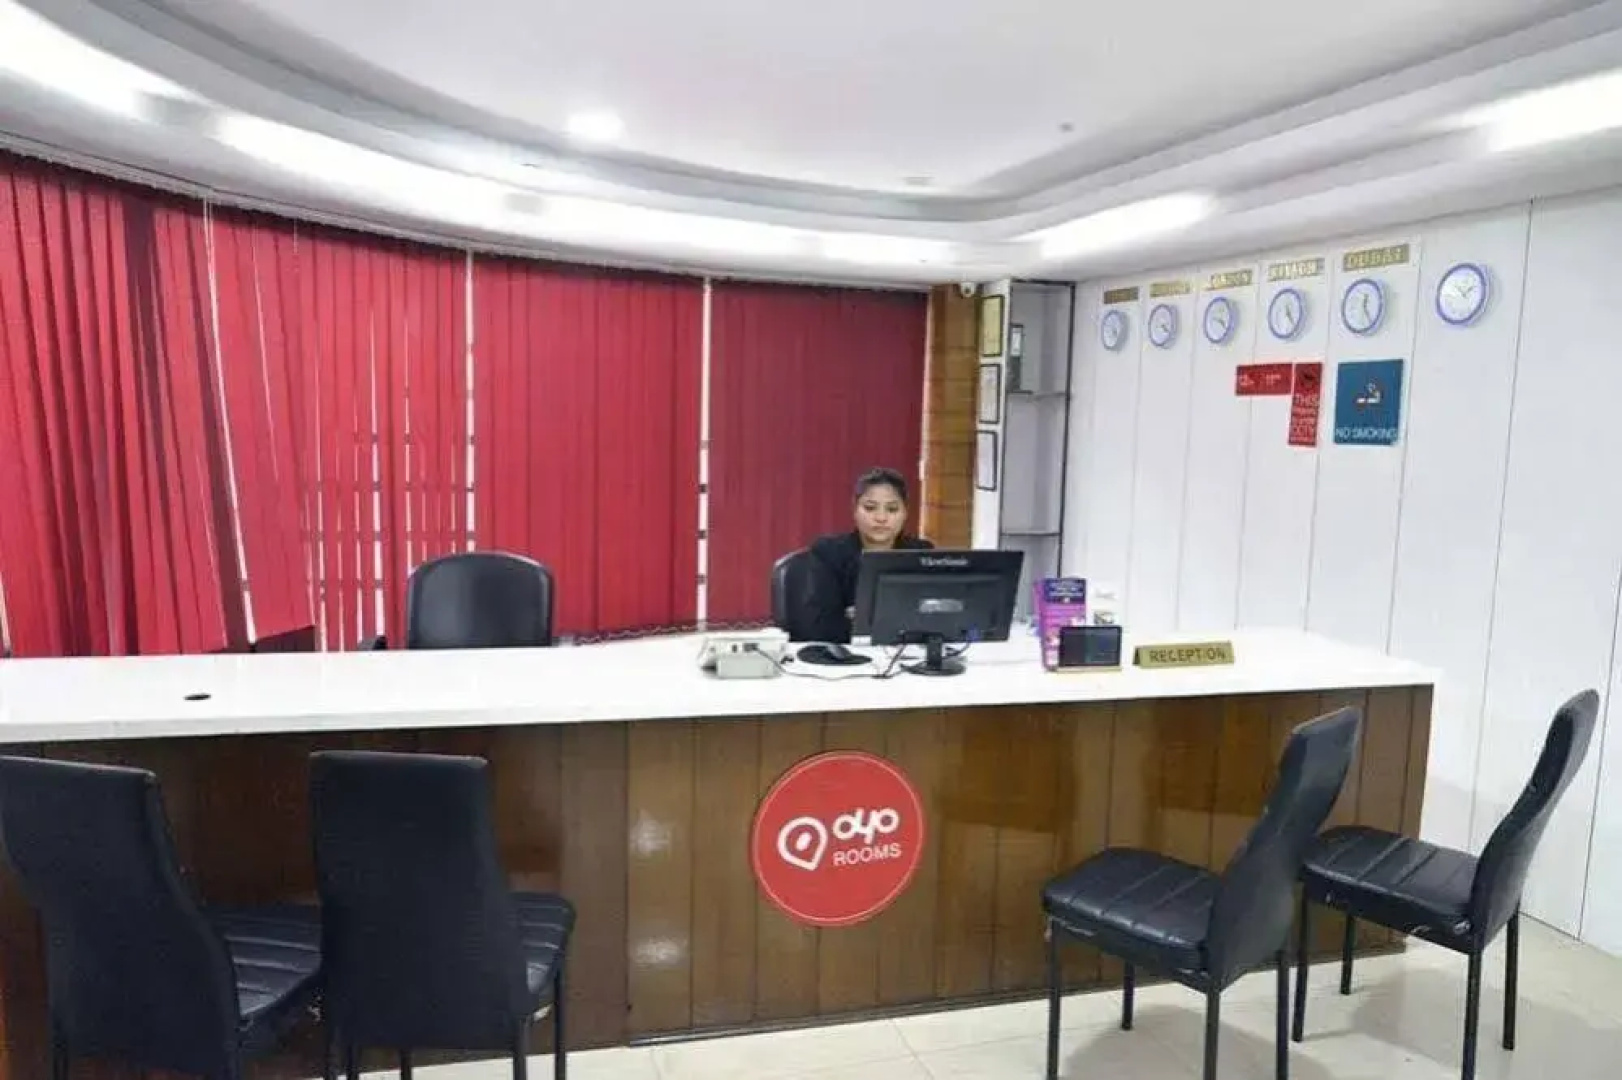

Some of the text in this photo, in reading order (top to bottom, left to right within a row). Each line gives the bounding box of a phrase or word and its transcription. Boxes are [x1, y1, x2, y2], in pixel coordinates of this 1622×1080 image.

[1335, 427, 1398, 439] NO SMOKING
[1150, 648, 1226, 663] RECEPTION
[832, 842, 902, 866] ROOMS
